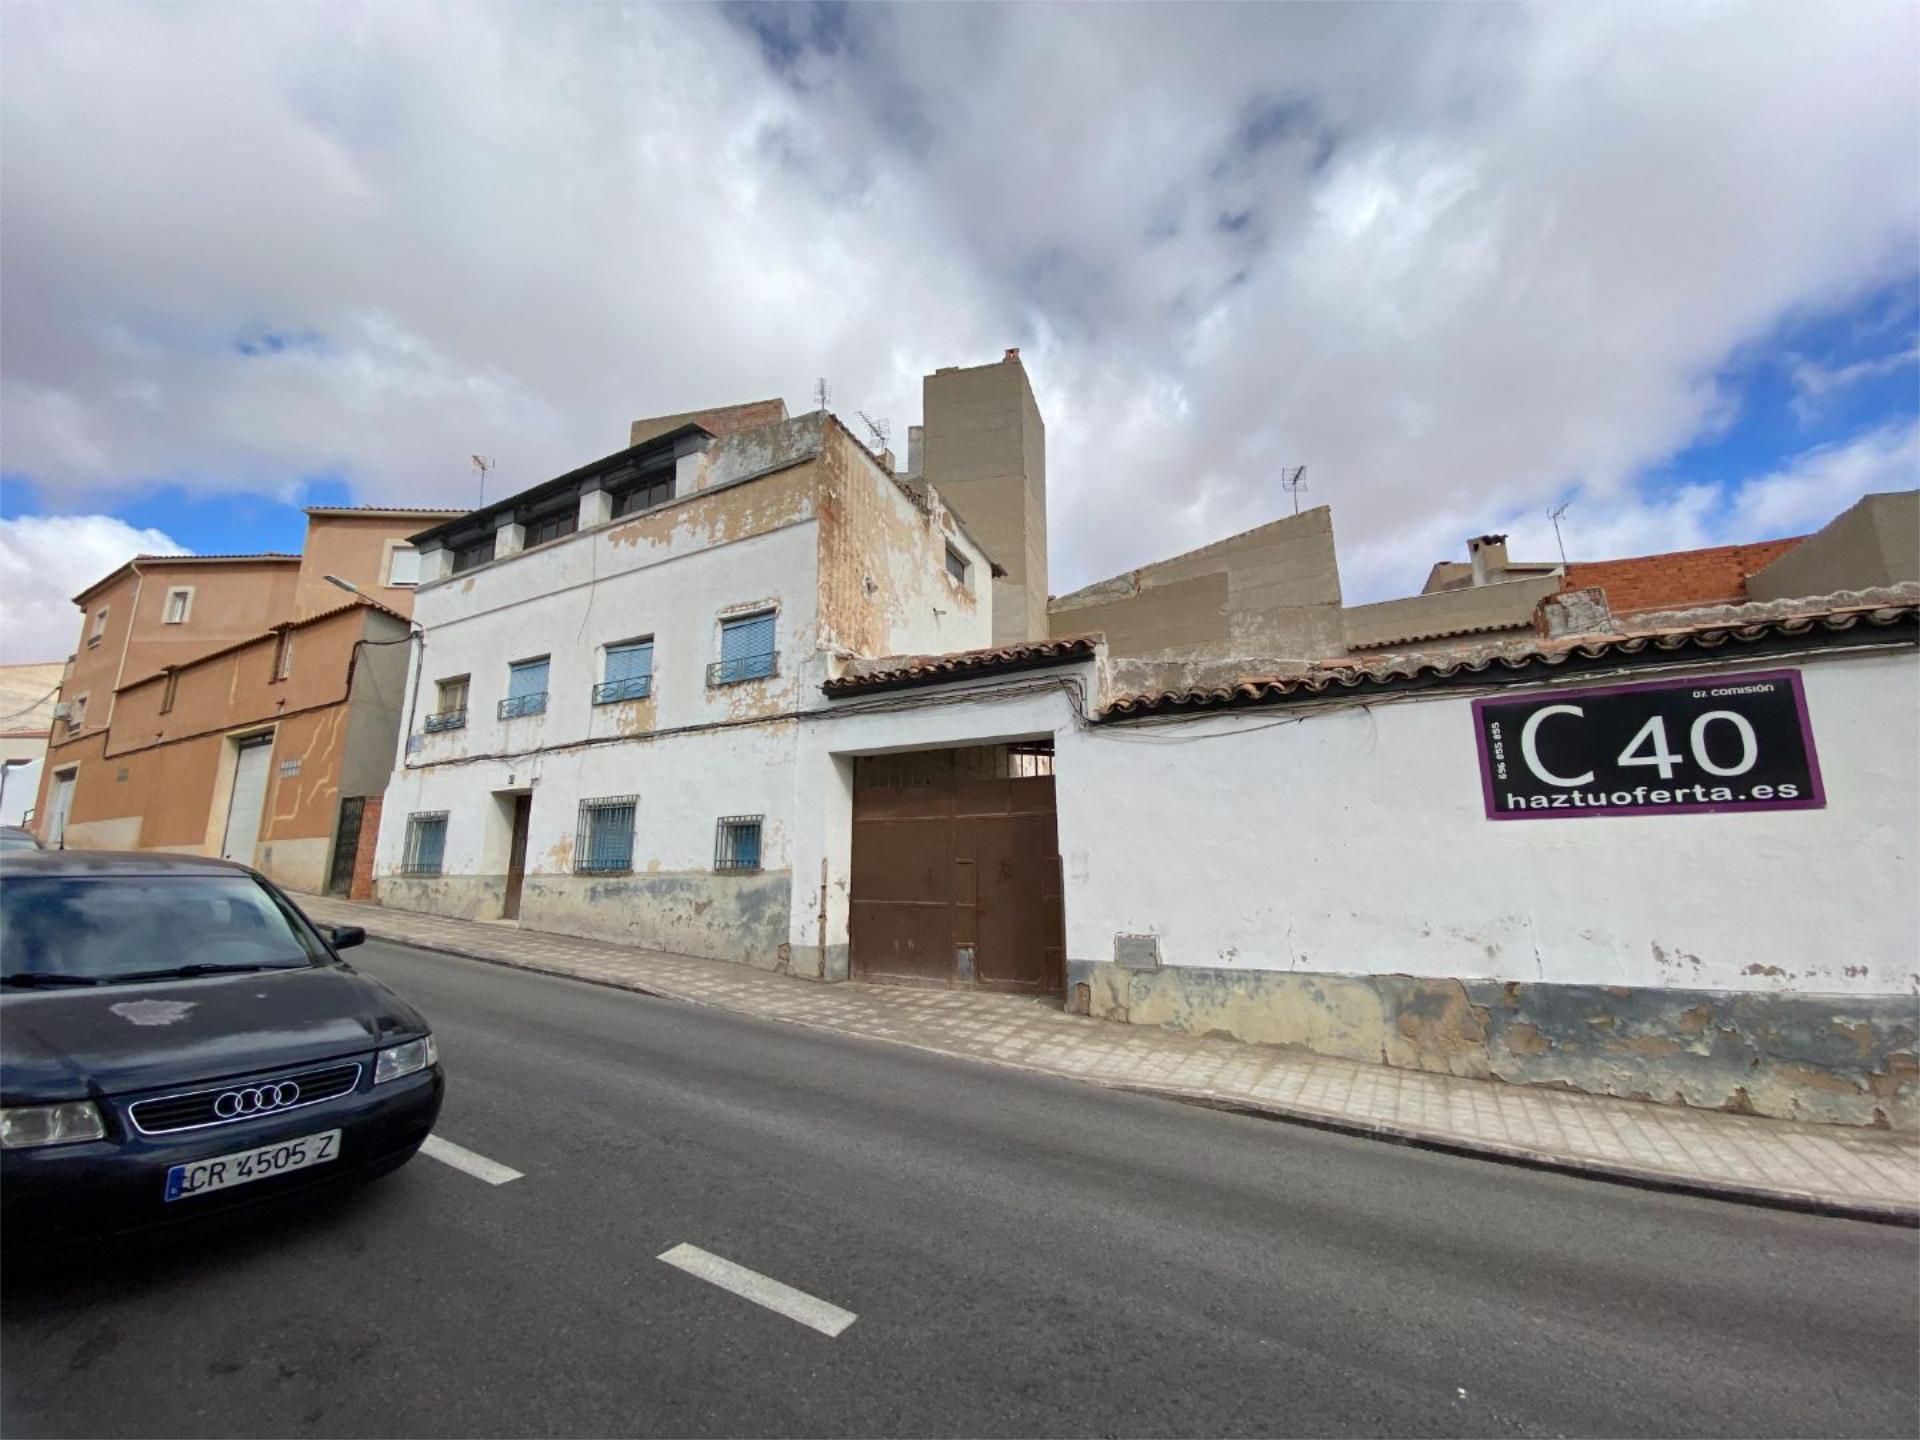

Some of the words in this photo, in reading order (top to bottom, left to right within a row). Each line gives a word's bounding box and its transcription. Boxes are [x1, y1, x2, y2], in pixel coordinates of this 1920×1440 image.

[1521, 705, 1594, 787] C
[1616, 710, 1759, 779] 40
[1507, 783, 1799, 809] haztuoferta.es
[190, 1162, 226, 1190] CR
[236, 1142, 306, 1178] 4505
[317, 1135, 334, 1160] Z
